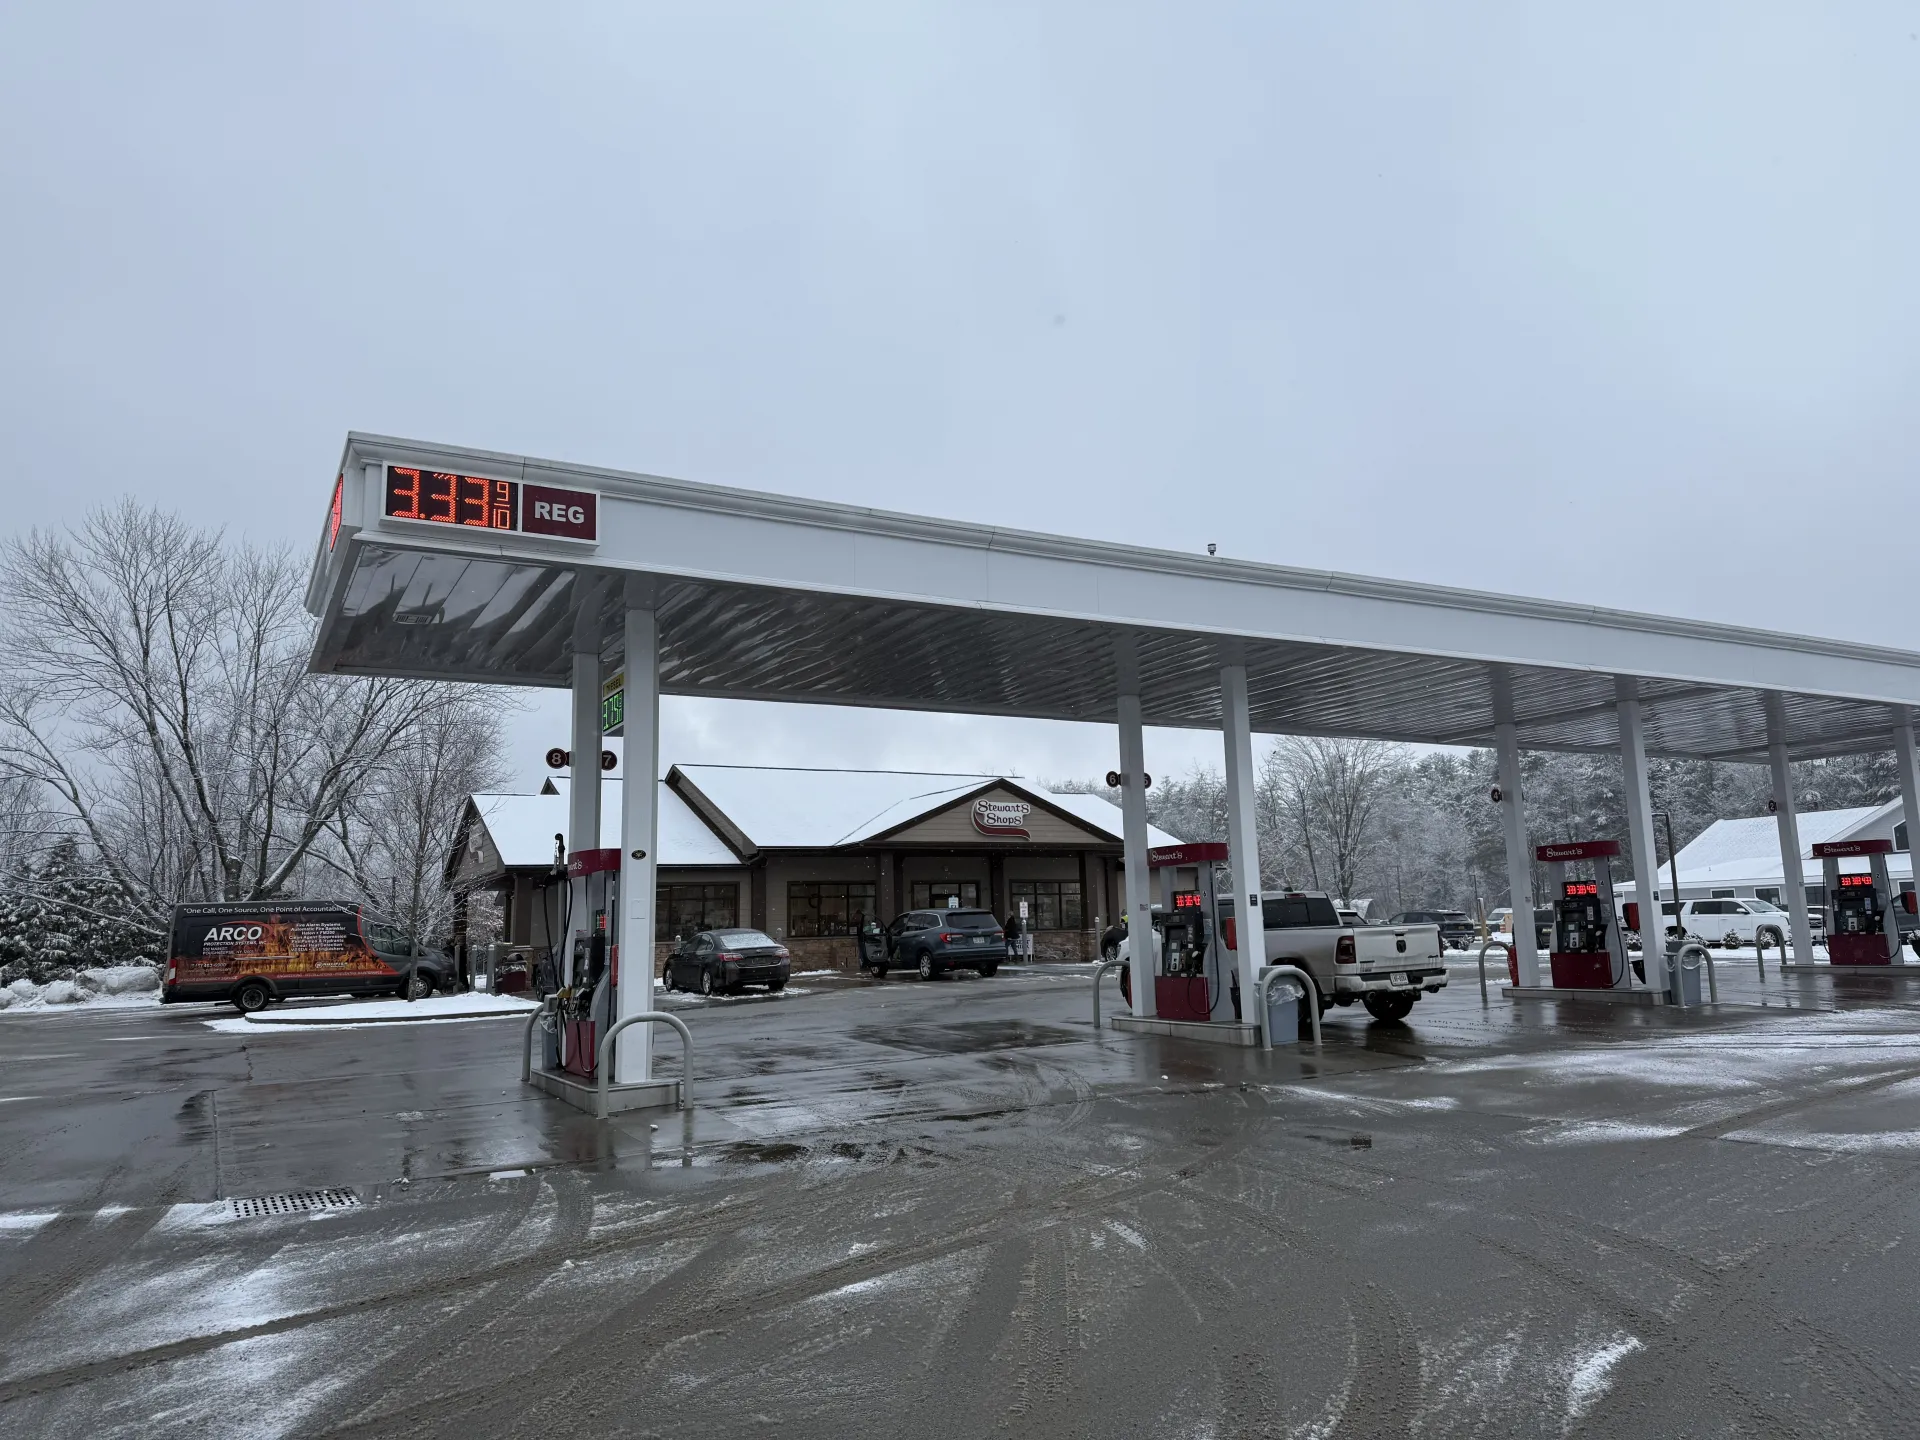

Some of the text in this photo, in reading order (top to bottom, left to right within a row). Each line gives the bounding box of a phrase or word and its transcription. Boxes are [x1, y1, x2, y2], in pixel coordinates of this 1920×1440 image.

[393, 467, 490, 527] 3.33
[534, 501, 585, 524] REG
[551, 752, 561, 764] 8
[602, 754, 611, 767] 7
[1110, 774, 1116, 785] 6
[986, 813, 1022, 825] Shops
[1546, 848, 1583, 857] Stewart's
[1824, 845, 1861, 853] Stewart's
[1151, 850, 1183, 862] Stewart's
[203, 926, 262, 941] ARCO
